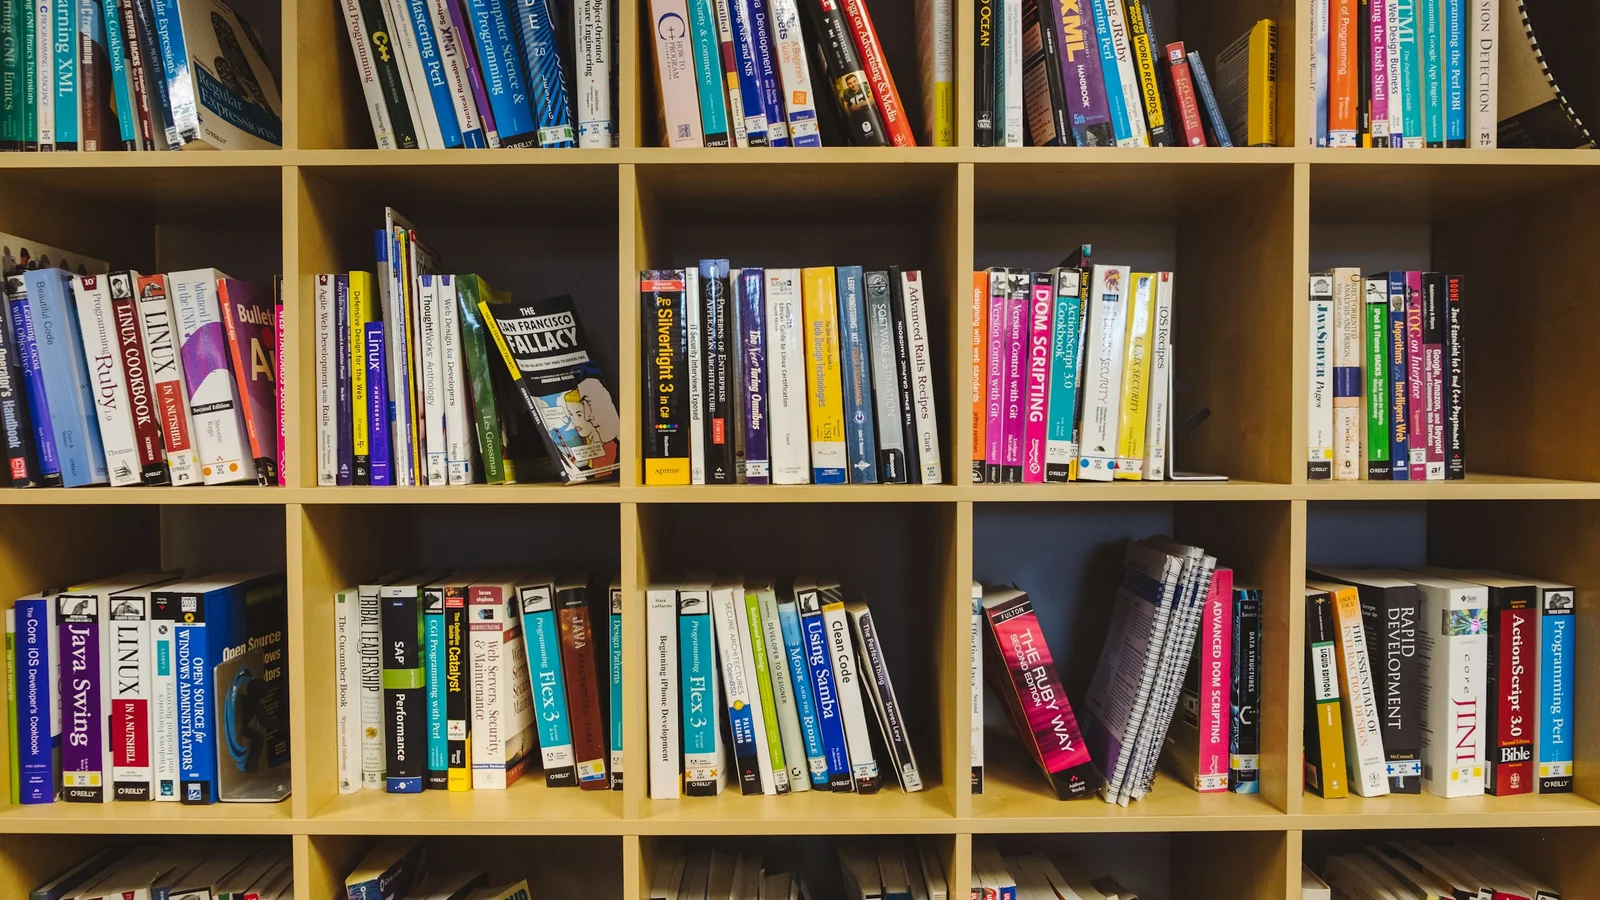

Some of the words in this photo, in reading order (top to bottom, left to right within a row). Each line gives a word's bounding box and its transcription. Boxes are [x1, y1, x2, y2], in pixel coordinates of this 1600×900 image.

[125, 8, 136, 39] SERVER
[1388, 3, 1398, 23] Web
[3, 37, 15, 67] GNU
[108, 21, 123, 72] Cookbook
[128, 41, 140, 66] HACKS
[160, 19, 176, 74] Expressions
[350, 14, 374, 83] Programming
[372, 31, 390, 62] C++
[439, 26, 456, 58] UNIX
[481, 11, 505, 95] Programming
[756, 13, 773, 75] Development
[937, 20, 951, 73] COMMUNITIES
[1108, 22, 1128, 63] JRuby
[1135, 36, 1150, 70] WORLD
[1268, 25, 1276, 50] DEEP
[1339, 18, 1349, 75] Programming
[1389, 25, 1398, 54] Design
[59, 59, 73, 97] XML
[429, 61, 445, 87] Perl
[451, 59, 464, 93] Reusable
[858, 30, 884, 81] Advertising
[880, 93, 898, 123] Media
[1268, 52, 1276, 83] WORK
[1374, 46, 1385, 71] bash
[1390, 56, 1399, 94] Business
[4, 71, 14, 110] Emacs
[158, 80, 168, 108] BROOKS
[1077, 65, 1090, 107] HANDBOOK
[1142, 72, 1158, 114] RECORDS
[1180, 77, 1198, 129] GO-GIVER
[1375, 75, 1385, 100] Shell
[458, 94, 472, 129] Practical
[1034, 289, 1049, 331] DOM
[1450, 279, 1459, 302] BOONE
[36, 281, 51, 319] Beautiful
[44, 321, 54, 345] Code
[92, 293, 110, 355] Programming
[117, 304, 137, 346] LINUX
[519, 314, 572, 331] FRANCISCO
[520, 306, 536, 316] THE
[908, 286, 922, 341] Advanced
[1011, 304, 1022, 340] Version
[1055, 302, 1066, 358] Cookbook
[1158, 306, 1169, 326] iOS
[507, 327, 578, 354] FALLACY
[655, 309, 674, 379] Silverlight
[749, 330, 760, 344] The
[1064, 302, 1078, 368] ActionScript
[1157, 328, 1168, 369] Recipes
[1392, 321, 1404, 365] Algorithms
[915, 344, 926, 372] Rails
[1010, 342, 1020, 378] Control
[1433, 349, 1441, 377] Google,
[94, 355, 118, 410] Ruby
[125, 348, 151, 426] COOKBOOK
[426, 361, 436, 406] Anthology
[749, 368, 761, 392] Turing
[916, 376, 930, 419] Recipes
[1009, 380, 1019, 402] with
[1029, 336, 1047, 422] SCRIPTING
[1063, 372, 1073, 389] 3.0
[1314, 381, 1325, 408] Pages
[750, 394, 761, 430] Omnibus
[1009, 404, 1018, 419] Git
[1395, 382, 1405, 422] Intelligent
[923, 432, 932, 453] Clark
[1396, 423, 1406, 443] Web
[1435, 425, 1443, 454] Beyond
[484, 432, 497, 476] Grossman
[360, 594, 379, 627] TRIBAL
[863, 623, 873, 637] The
[1212, 601, 1222, 658] ADVANCED
[27, 619, 38, 644] Core
[68, 624, 90, 672] Java
[487, 640, 500, 662] Web
[536, 617, 549, 668] Programming
[808, 620, 825, 666] Using
[866, 638, 879, 663] Perfect
[1352, 623, 1363, 648] THE
[1400, 607, 1415, 657] RAPID
[28, 648, 39, 666] iOS
[117, 625, 140, 696] LINUX
[339, 635, 347, 682] Cucumber
[361, 631, 380, 692] LEADERSHIP
[429, 640, 439, 698] Programming
[447, 647, 461, 693] Catalyst
[659, 635, 668, 677] Beginning
[832, 620, 844, 652] Clean
[838, 654, 851, 683] Code
[1388, 607, 1401, 730] DEVELOPMENT
[1508, 614, 1525, 711] ActionScript
[1551, 620, 1565, 714] Programming
[29, 669, 38, 714] Developer's
[475, 653, 486, 721] Maintenance
[486, 665, 500, 707] Servers,
[539, 671, 555, 708] Flex
[661, 678, 669, 707] iPhone
[872, 664, 886, 685] Thing
[1019, 629, 1039, 664] THE
[1032, 665, 1058, 710] RUBY
[1050, 715, 1074, 753] WAY
[1212, 661, 1221, 687] DOM
[1343, 625, 1361, 701] INTERACTION
[1354, 702, 1368, 747] DESIGN
[1355, 650, 1374, 718] ESSENTIALS
[70, 678, 92, 747] Swing
[432, 701, 440, 720] with
[816, 669, 835, 719] Samba
[886, 702, 897, 725] Steven
[30, 716, 39, 755] Cookbook
[395, 694, 406, 761] Performance
[432, 723, 440, 739] Perl
[486, 710, 500, 756] Security,
[543, 710, 560, 722] 3
[661, 709, 670, 762] Development
[890, 726, 902, 742] Levy
[1210, 690, 1220, 744] SCRIPTING
[1451, 696, 1477, 764] JINI
[1510, 715, 1522, 737] 3.0
[1552, 718, 1563, 744] Perl
[1500, 747, 1530, 763] Bible
